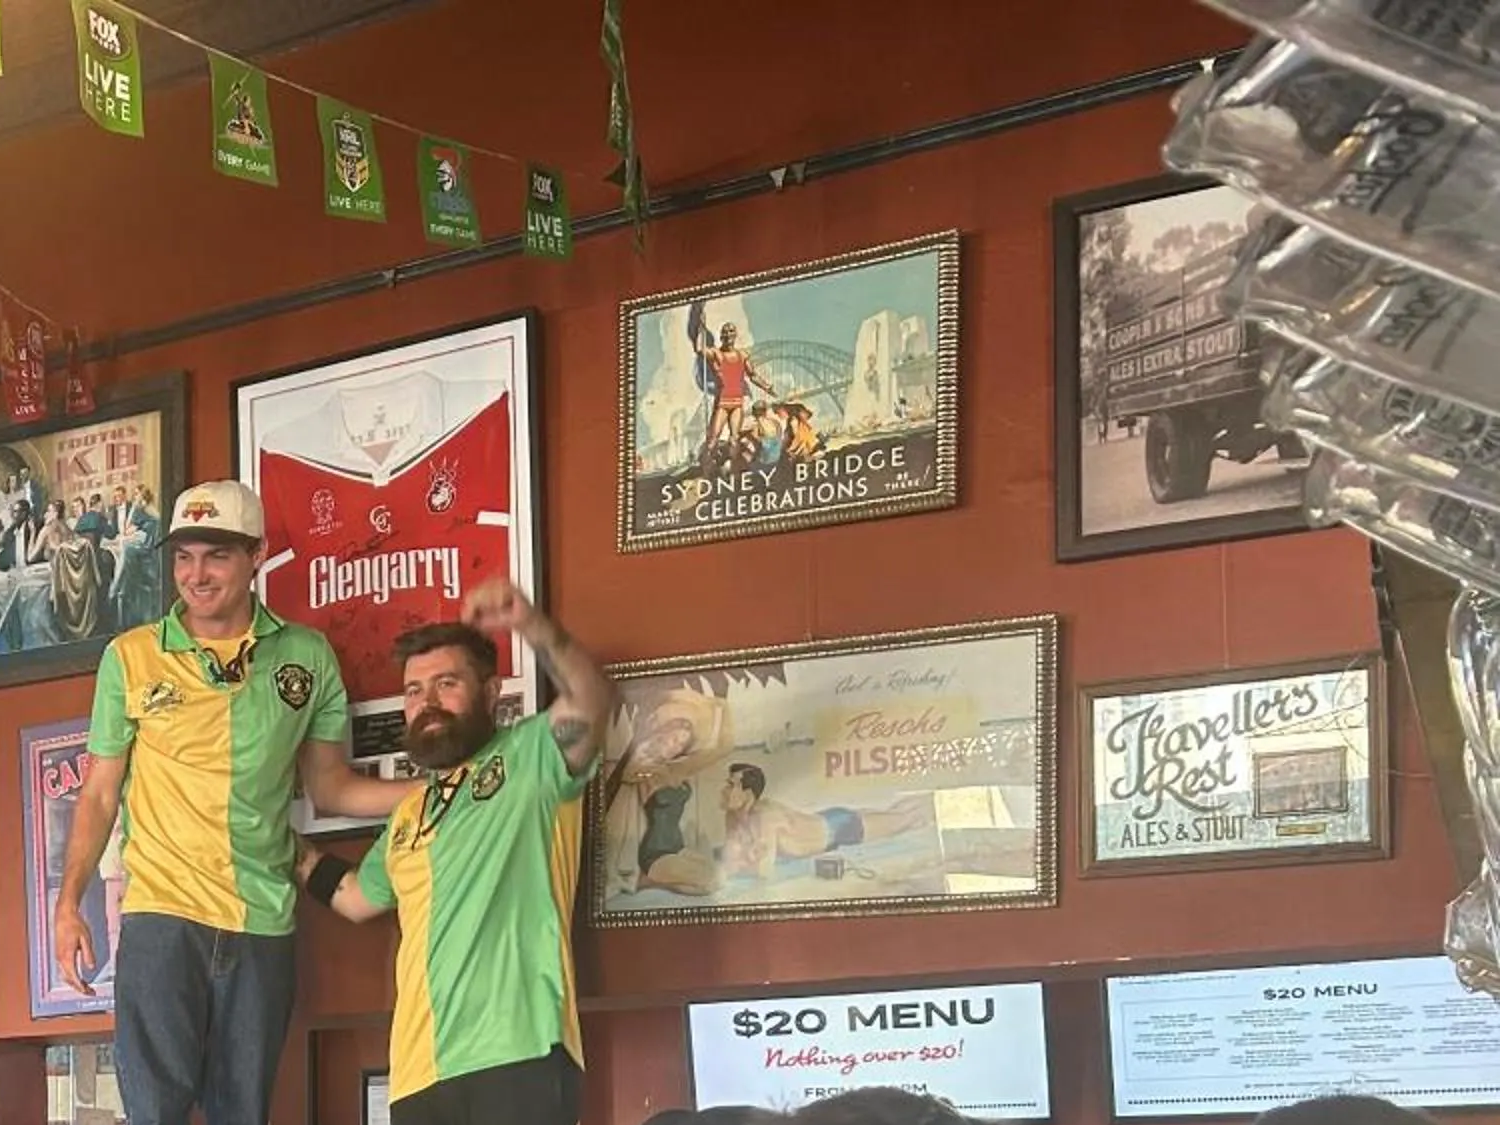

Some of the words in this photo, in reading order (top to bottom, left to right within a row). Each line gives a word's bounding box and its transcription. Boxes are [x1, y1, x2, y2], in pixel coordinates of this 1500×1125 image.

[88, 9, 120, 44] FOX
[85, 53, 131, 101] LIVE
[86, 84, 131, 122] HERE
[329, 195, 351, 209] LIVE
[526, 211, 563, 237] LIVE
[527, 234, 565, 255] HERE
[1186, 325, 1235, 361] STOUT
[661, 466, 777, 504] SYDNEY
[795, 446, 906, 482] BRIDGE
[695, 477, 868, 522] CELEBRATIONS
[309, 547, 460, 610] Glengarry
[845, 705, 948, 742] Reschs
[1107, 683, 1319, 800] Travellers
[1132, 744, 1238, 821] Rest
[1120, 820, 1171, 849] ALES
[1176, 824, 1190, 842] &
[1192, 814, 1249, 843] STOUT
[1262, 988, 1305, 1001] $20
[1314, 983, 1379, 998] MENU
[732, 1007, 828, 1039] $20
[847, 997, 995, 1032] MENU
[764, 1045, 859, 1075] Nothing
[862, 1048, 914, 1066] over
[919, 1038, 966, 1062] $20!
[803, 1086, 850, 1100] FRO
